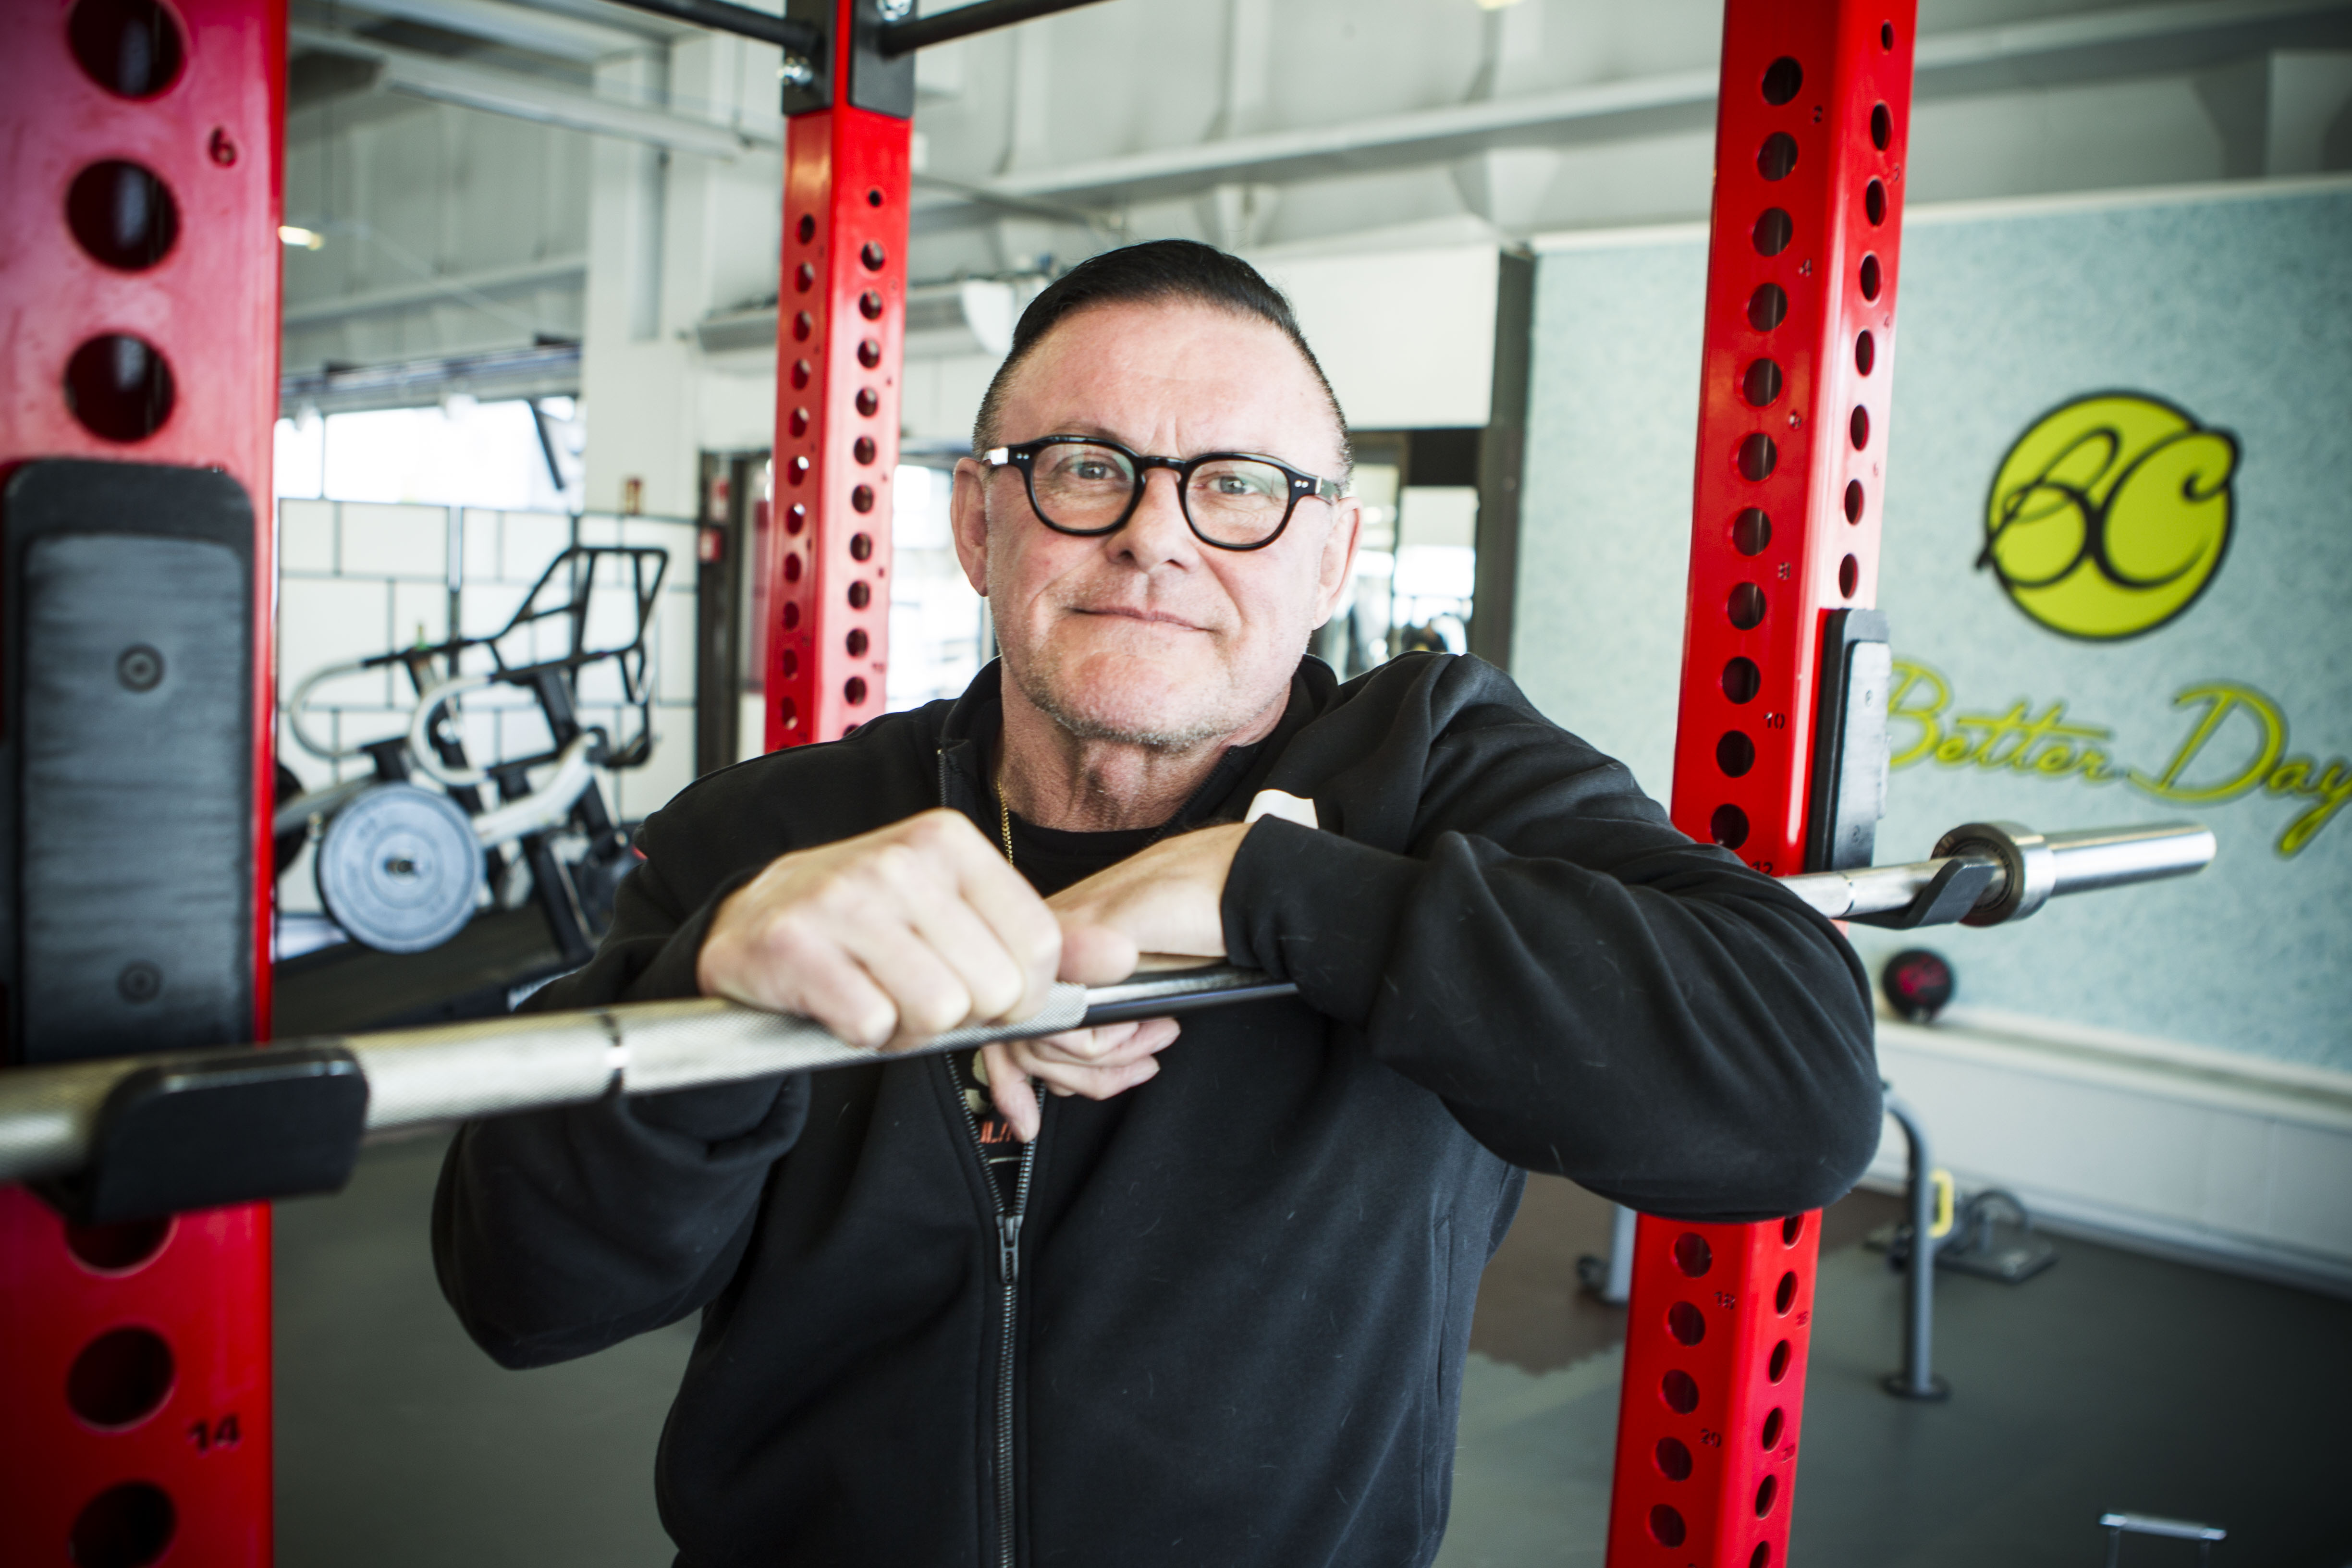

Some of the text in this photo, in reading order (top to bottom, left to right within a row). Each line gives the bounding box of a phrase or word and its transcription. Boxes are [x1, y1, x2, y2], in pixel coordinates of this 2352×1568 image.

[1813, 105, 1823, 123] 2
[208, 127, 237, 167] 6
[1798, 258, 1813, 277] 4
[1777, 562, 1791, 580] 8
[1764, 711, 1785, 730] 10
[1888, 658, 2115, 783] Better
[1714, 1291, 1736, 1311] 18
[188, 1413, 242, 1451] 14
[1700, 1428, 1722, 1448] 20
